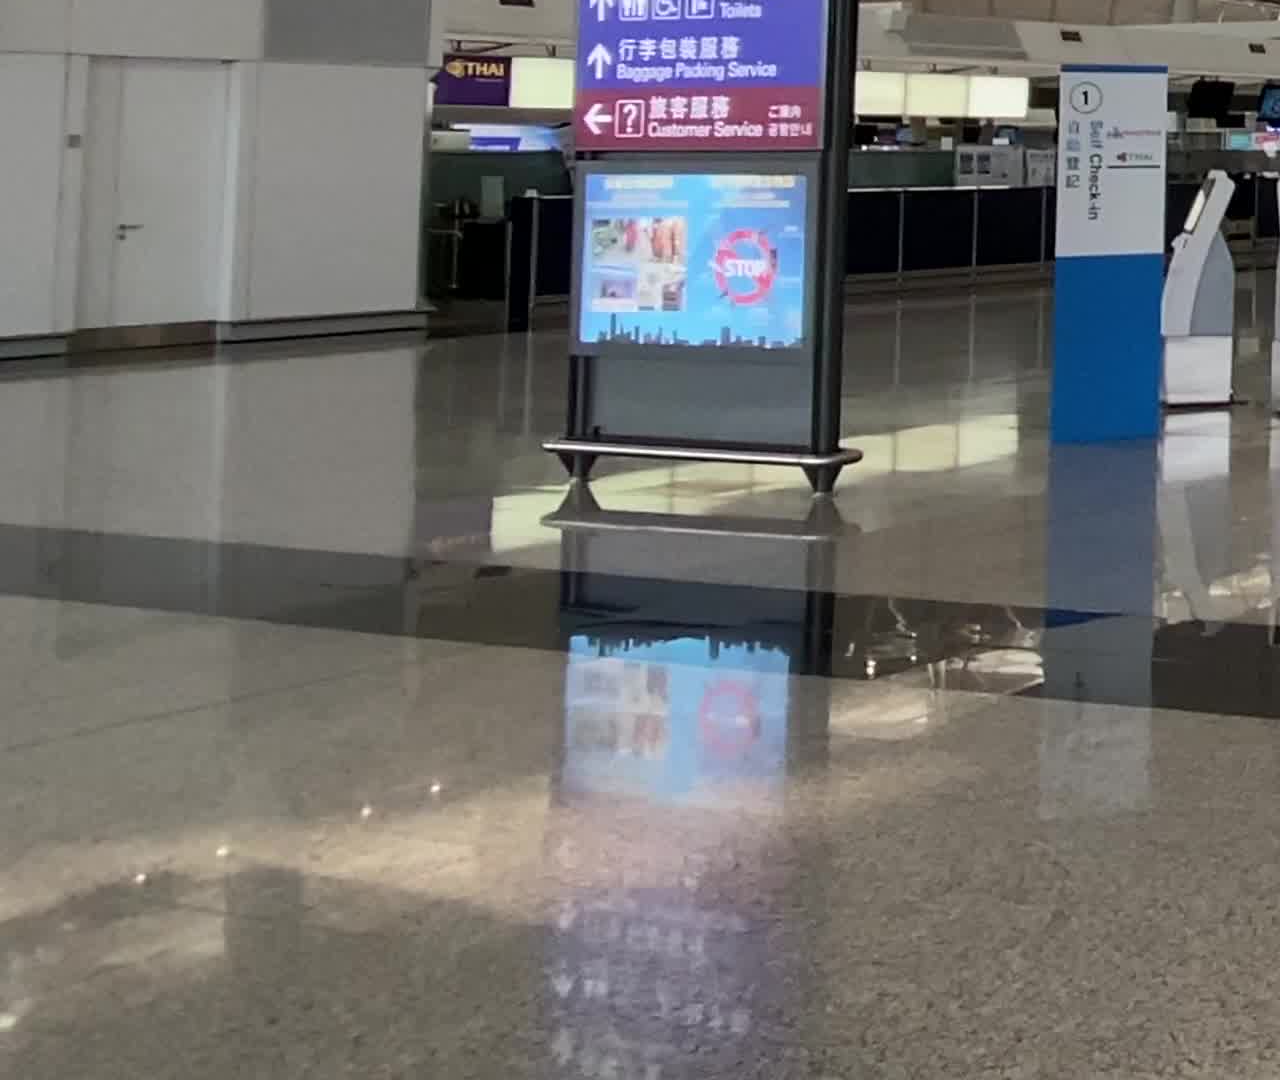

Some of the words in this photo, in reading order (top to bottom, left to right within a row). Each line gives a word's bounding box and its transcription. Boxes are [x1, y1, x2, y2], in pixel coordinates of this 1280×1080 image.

[719, 1, 763, 19] Toilets
[618, 36, 741, 61] 行李包裝服務
[466, 63, 504, 77] THAI
[616, 63, 673, 83] Baggage
[675, 61, 725, 82] Packing
[727, 59, 777, 78] Service
[648, 95, 730, 119] 旅客服務
[648, 121, 713, 138] Customer
[713, 120, 764, 138] Service
[1087, 153, 1103, 221] Check-in
[723, 258, 768, 278] STOP
